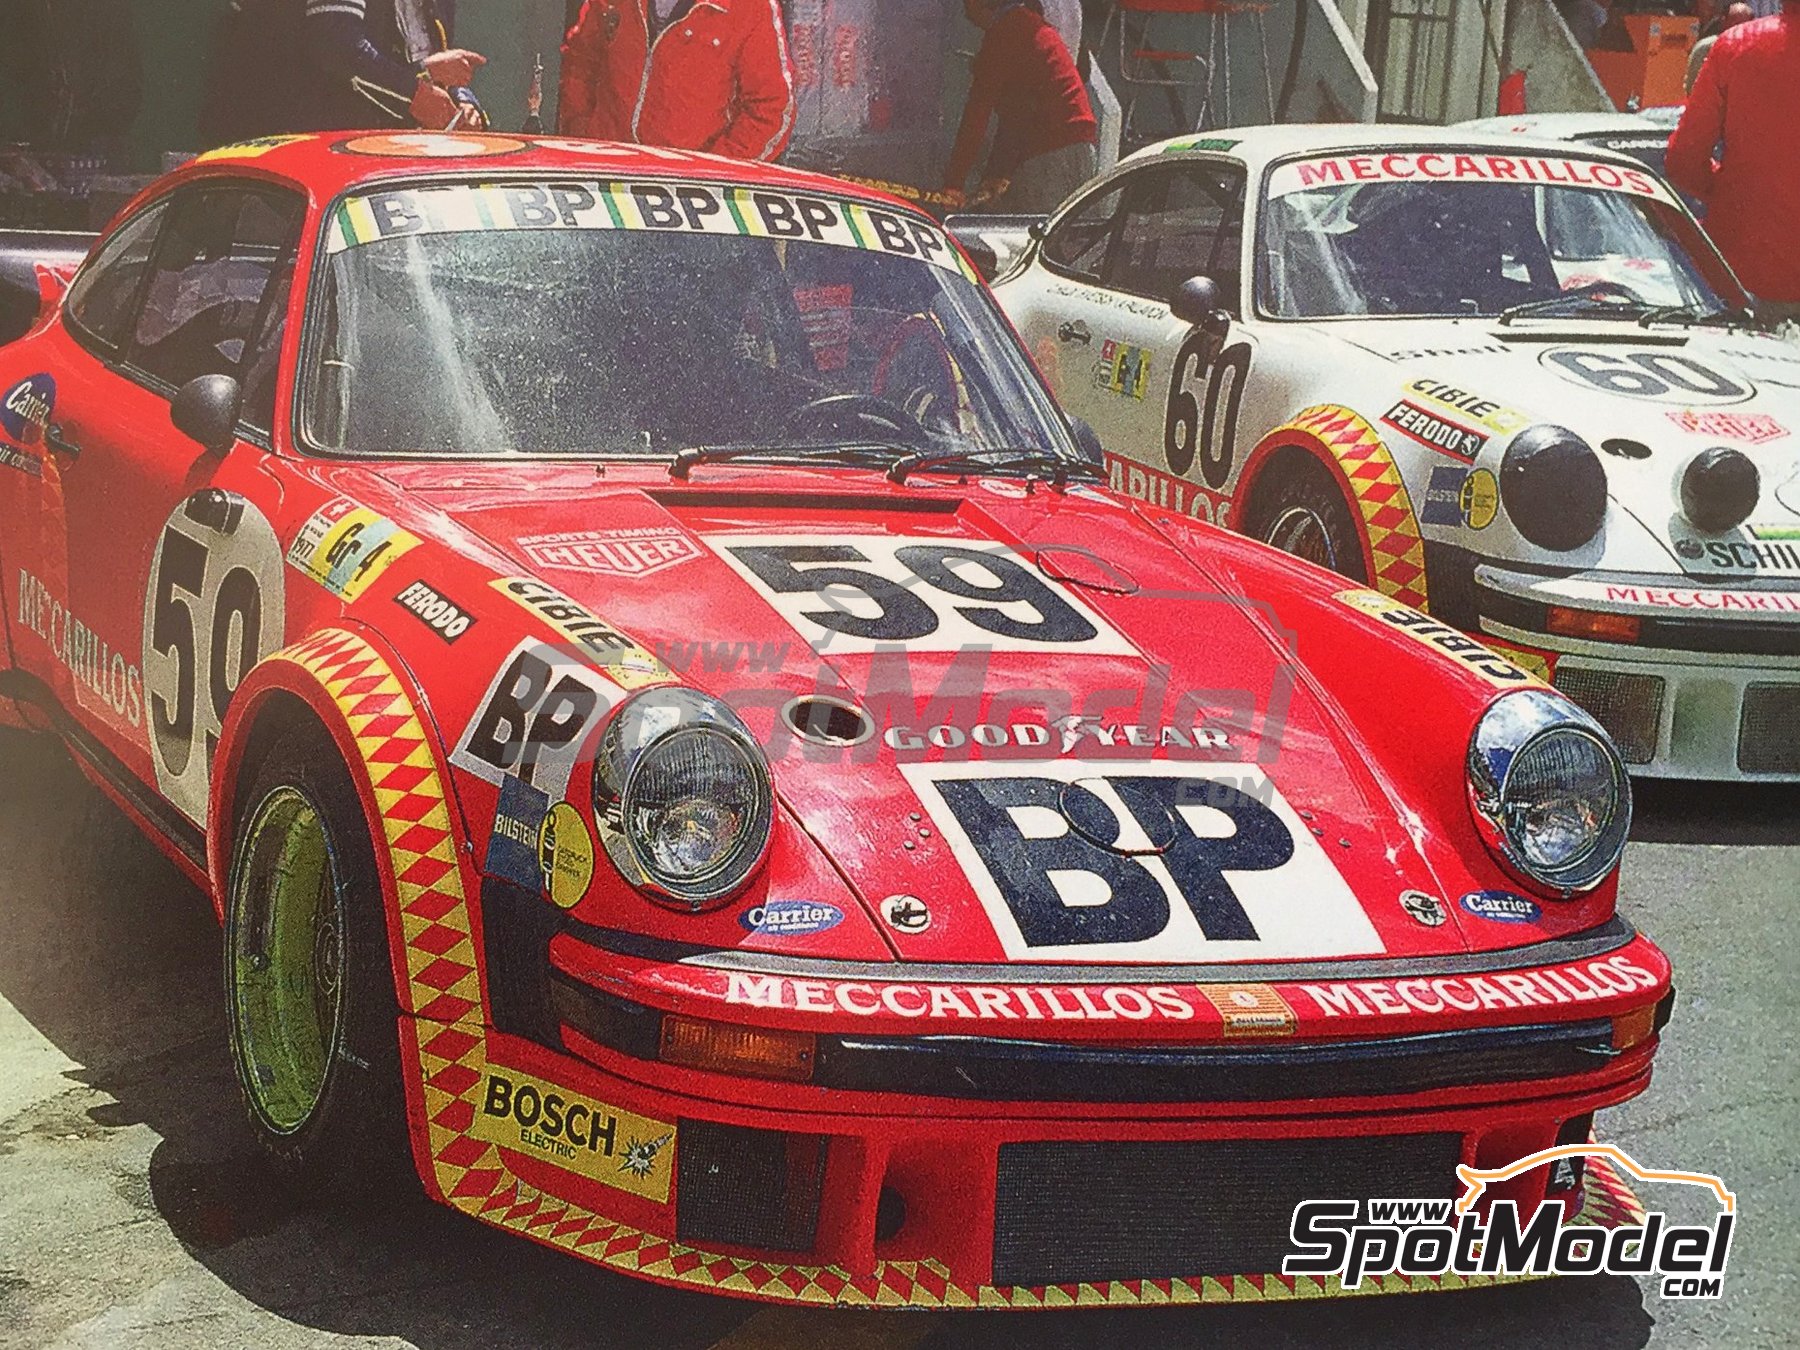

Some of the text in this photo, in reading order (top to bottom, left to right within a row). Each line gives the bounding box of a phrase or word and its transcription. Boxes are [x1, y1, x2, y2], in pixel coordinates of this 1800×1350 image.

[1299, 153, 1655, 195] MECCARILLOS
[629, 184, 720, 229] BP
[753, 193, 838, 240] BP
[870, 211, 943, 260] BP
[1411, 378, 1501, 417] CIBIE
[1547, 351, 1745, 396] 60
[1164, 323, 1253, 491] 60
[1388, 402, 1461, 450] FERODO
[325, 522, 365, 569] Gr
[358, 541, 392, 582] 4
[541, 541, 687, 572] HEUER
[396, 582, 473, 637] FERODO
[508, 582, 635, 653] CIBIE
[725, 544, 1098, 642] 59
[1381, 609, 1527, 680] CIBIE
[465, 650, 597, 786] BP
[494, 814, 540, 850] BILSTEIN
[932, 775, 1294, 947] BP
[748, 905, 834, 927] Carrier
[1466, 894, 1534, 914] Carrier
[726, 956, 1659, 1021] MECCARILLOS MECCARILLOS
[484, 1075, 617, 1157] BOSCH
[521, 1129, 577, 1161] ELECTRIC
